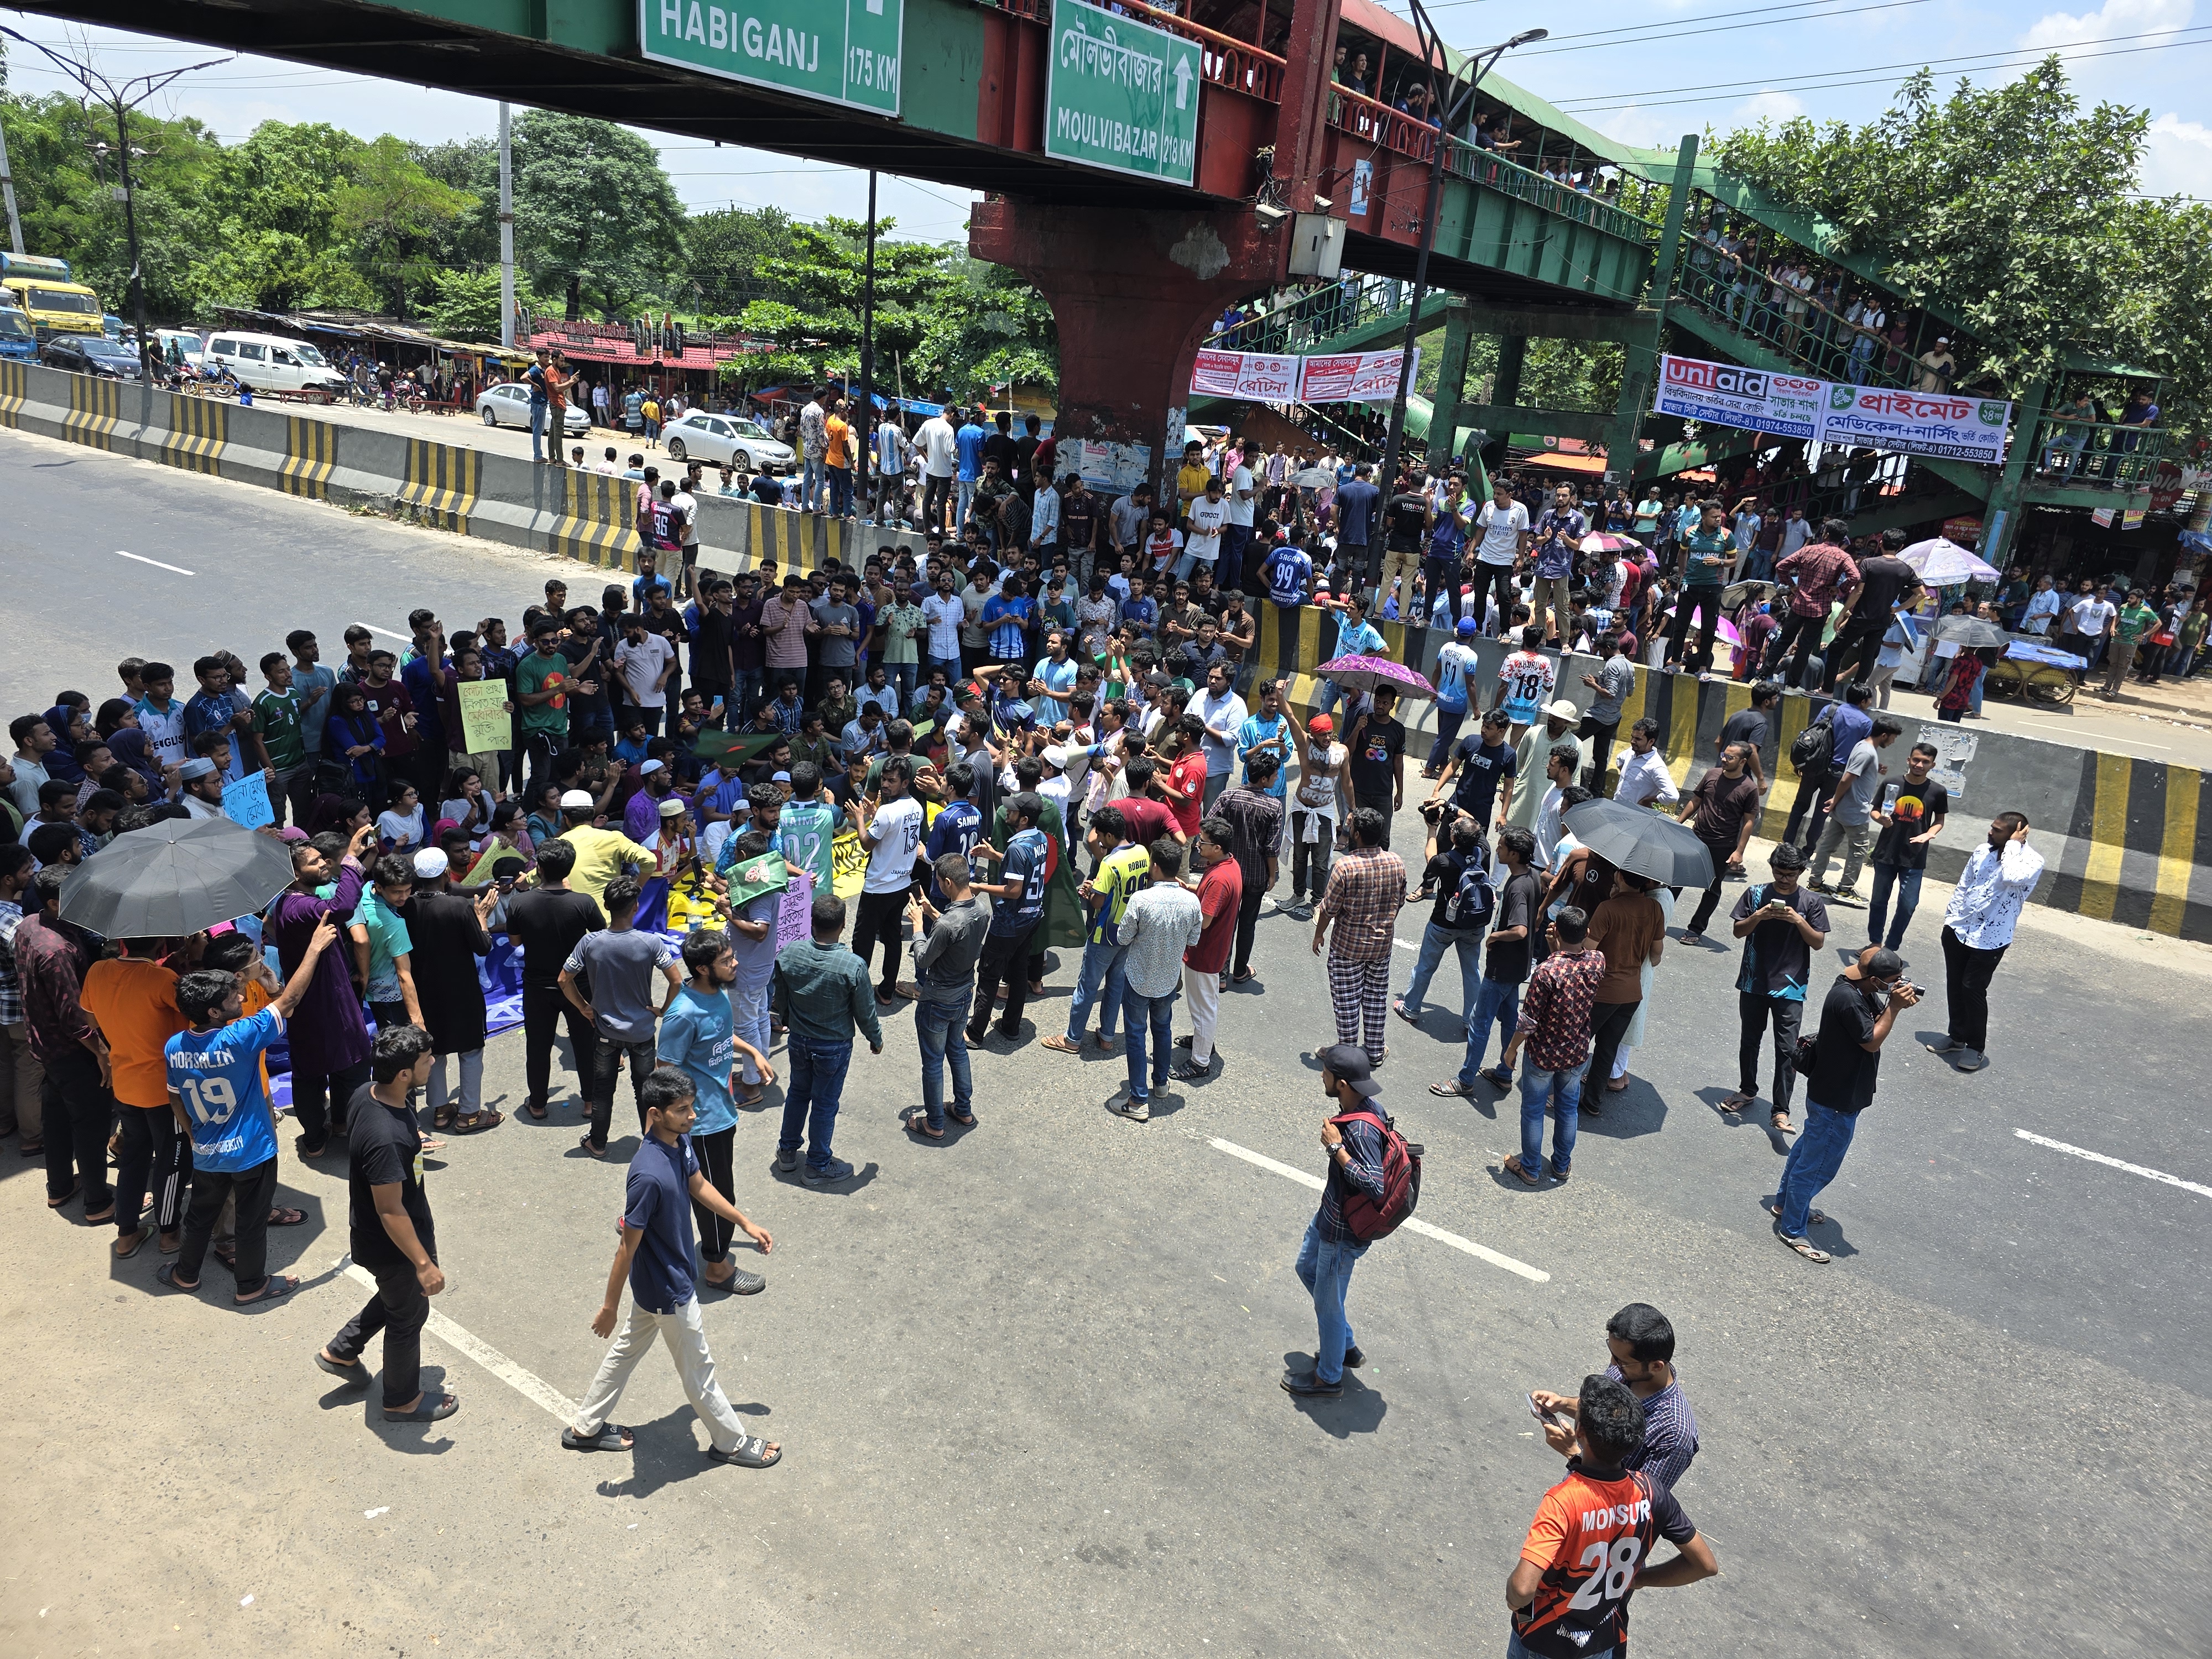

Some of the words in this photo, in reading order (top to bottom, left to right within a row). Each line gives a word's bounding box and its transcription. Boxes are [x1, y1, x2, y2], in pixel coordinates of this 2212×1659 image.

[661, 0, 818, 72] HABIGANJ
[1061, 14, 1163, 97] মৌলভীবাজার
[850, 46, 872, 87] 175
[877, 54, 896, 93] KM
[1057, 107, 1157, 160] MOULVIBAZAR
[1164, 135, 1177, 164] 218
[1179, 138, 1192, 168] KM
[1238, 377, 1289, 393] রেটিনা
[1665, 385, 1703, 403] বিশ্ববিদ্যালয়
[1705, 393, 1724, 406] ভর্তির
[1726, 398, 1741, 409] সেরা
[1743, 401, 1764, 415] কোচিং
[1770, 395, 1796, 409] সাভার
[1798, 398, 1819, 413] শাখা
[1859, 392, 1975, 421] প্রাইমেট
[1663, 400, 1682, 413] সাভার
[1683, 403, 1699, 415] সিটি
[1699, 407, 1720, 421] সেন্টার
[1721, 411, 1754, 428] (লিফট-৪)
[1756, 419, 1812, 436] 01974-553850
[1773, 409, 1788, 419] ভর্তি
[1791, 413, 1811, 422] চলছে
[1982, 409, 1994, 421] ২৪
[1856, 435, 1873, 446] সাভার
[1874, 437, 1886, 447] সিটি
[1887, 439, 1906, 450] সেন্টার
[1908, 441, 1937, 455] (লিফট-৪)
[1938, 446, 1993, 460] 01712-553850
[1961, 430, 1975, 441] ভর্তি
[1979, 432, 1999, 444] কোচিং
[1402, 502, 1425, 512] VISION
[654, 514, 668, 536] 96
[1489, 524, 1512, 532] Emirates
[1275, 562, 1294, 589] 99
[463, 685, 483, 697] কোটা
[1515, 673, 1539, 701] 18
[463, 698, 489, 710] নিপাত
[288, 712, 294, 725] 8
[488, 736, 509, 745] পাক
[238, 784, 248, 799] না
[247, 801, 265, 826] মেধা
[783, 832, 822, 869] 02
[903, 824, 919, 855] 13
[778, 908, 805, 926] অধিকার
[170, 1048, 236, 1069] MORSALIN
[708, 1056, 723, 1067] মিনি
[182, 1077, 237, 1125] 19
[1567, 1537, 1641, 1610] 28
